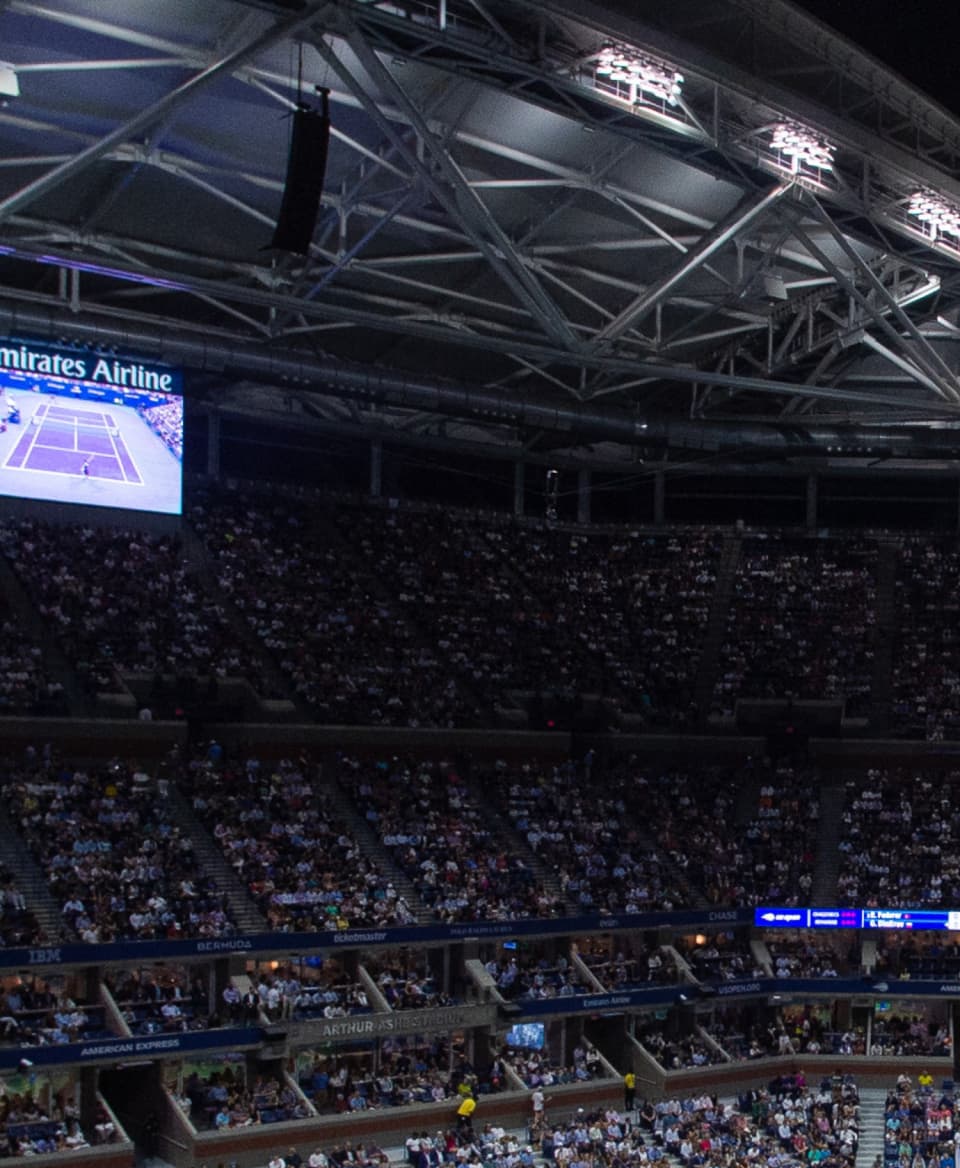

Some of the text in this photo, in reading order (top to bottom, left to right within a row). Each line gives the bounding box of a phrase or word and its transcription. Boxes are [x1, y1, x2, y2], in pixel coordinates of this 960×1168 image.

[92, 358, 173, 392] Airline
[197, 940, 252, 951] BERMUDA
[334, 931, 388, 944] ticketmaster
[29, 949, 61, 964] IBM
[323, 1020, 374, 1037] ARTHUR
[81, 1038, 180, 1056] AMERICAN EXPRESS
